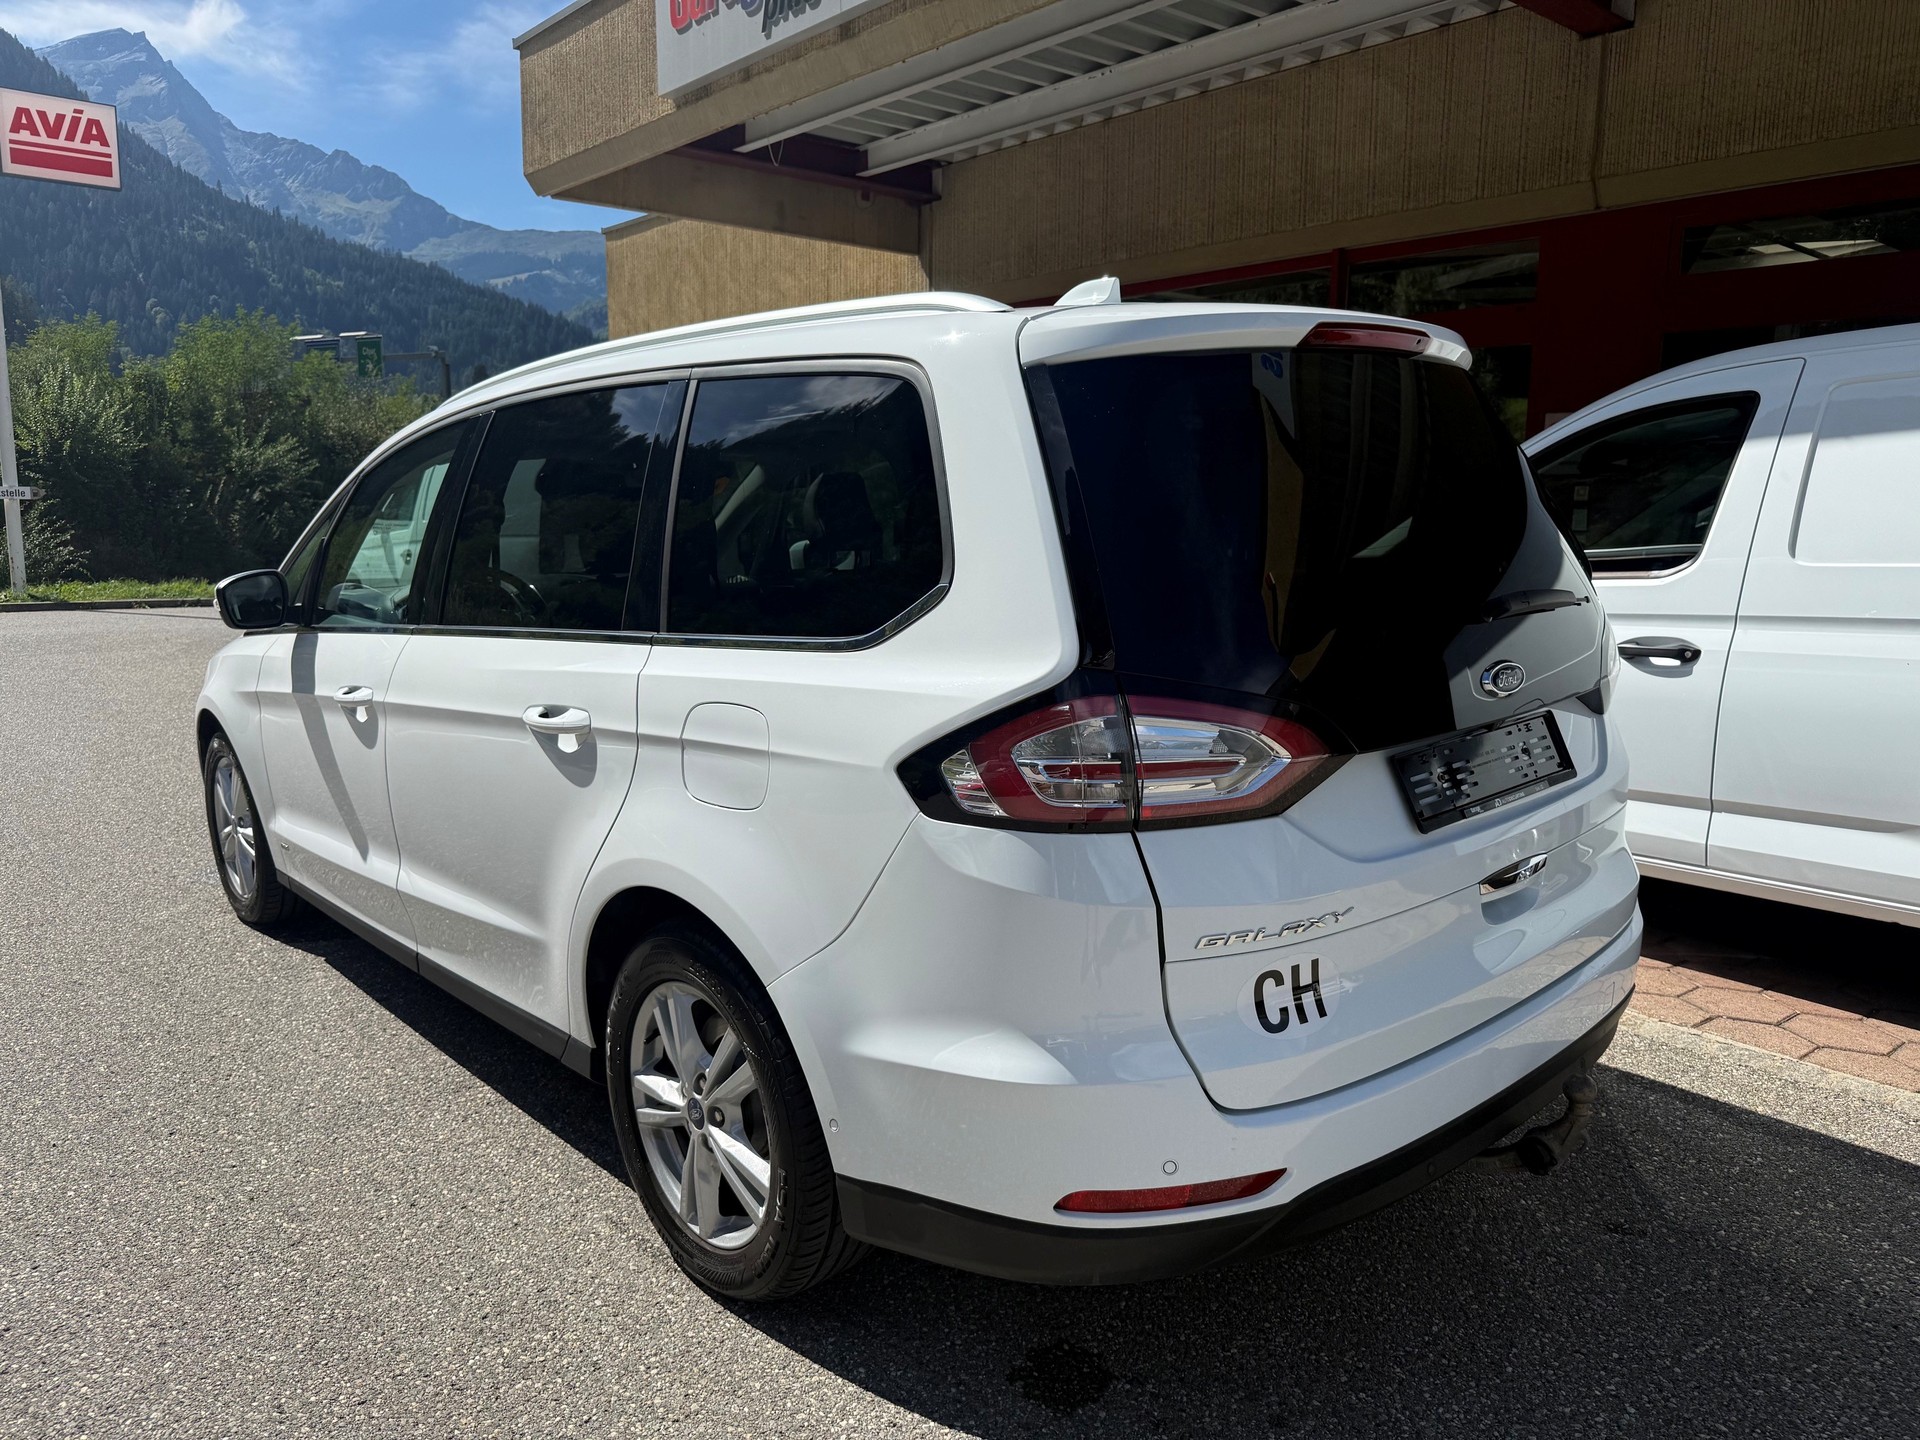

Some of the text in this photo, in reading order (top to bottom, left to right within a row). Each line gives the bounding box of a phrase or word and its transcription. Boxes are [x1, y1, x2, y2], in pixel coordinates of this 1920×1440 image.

[0, 489, 26, 498] stelle
[1194, 906, 1355, 950] GALAXY
[1253, 957, 1328, 1034] CH
